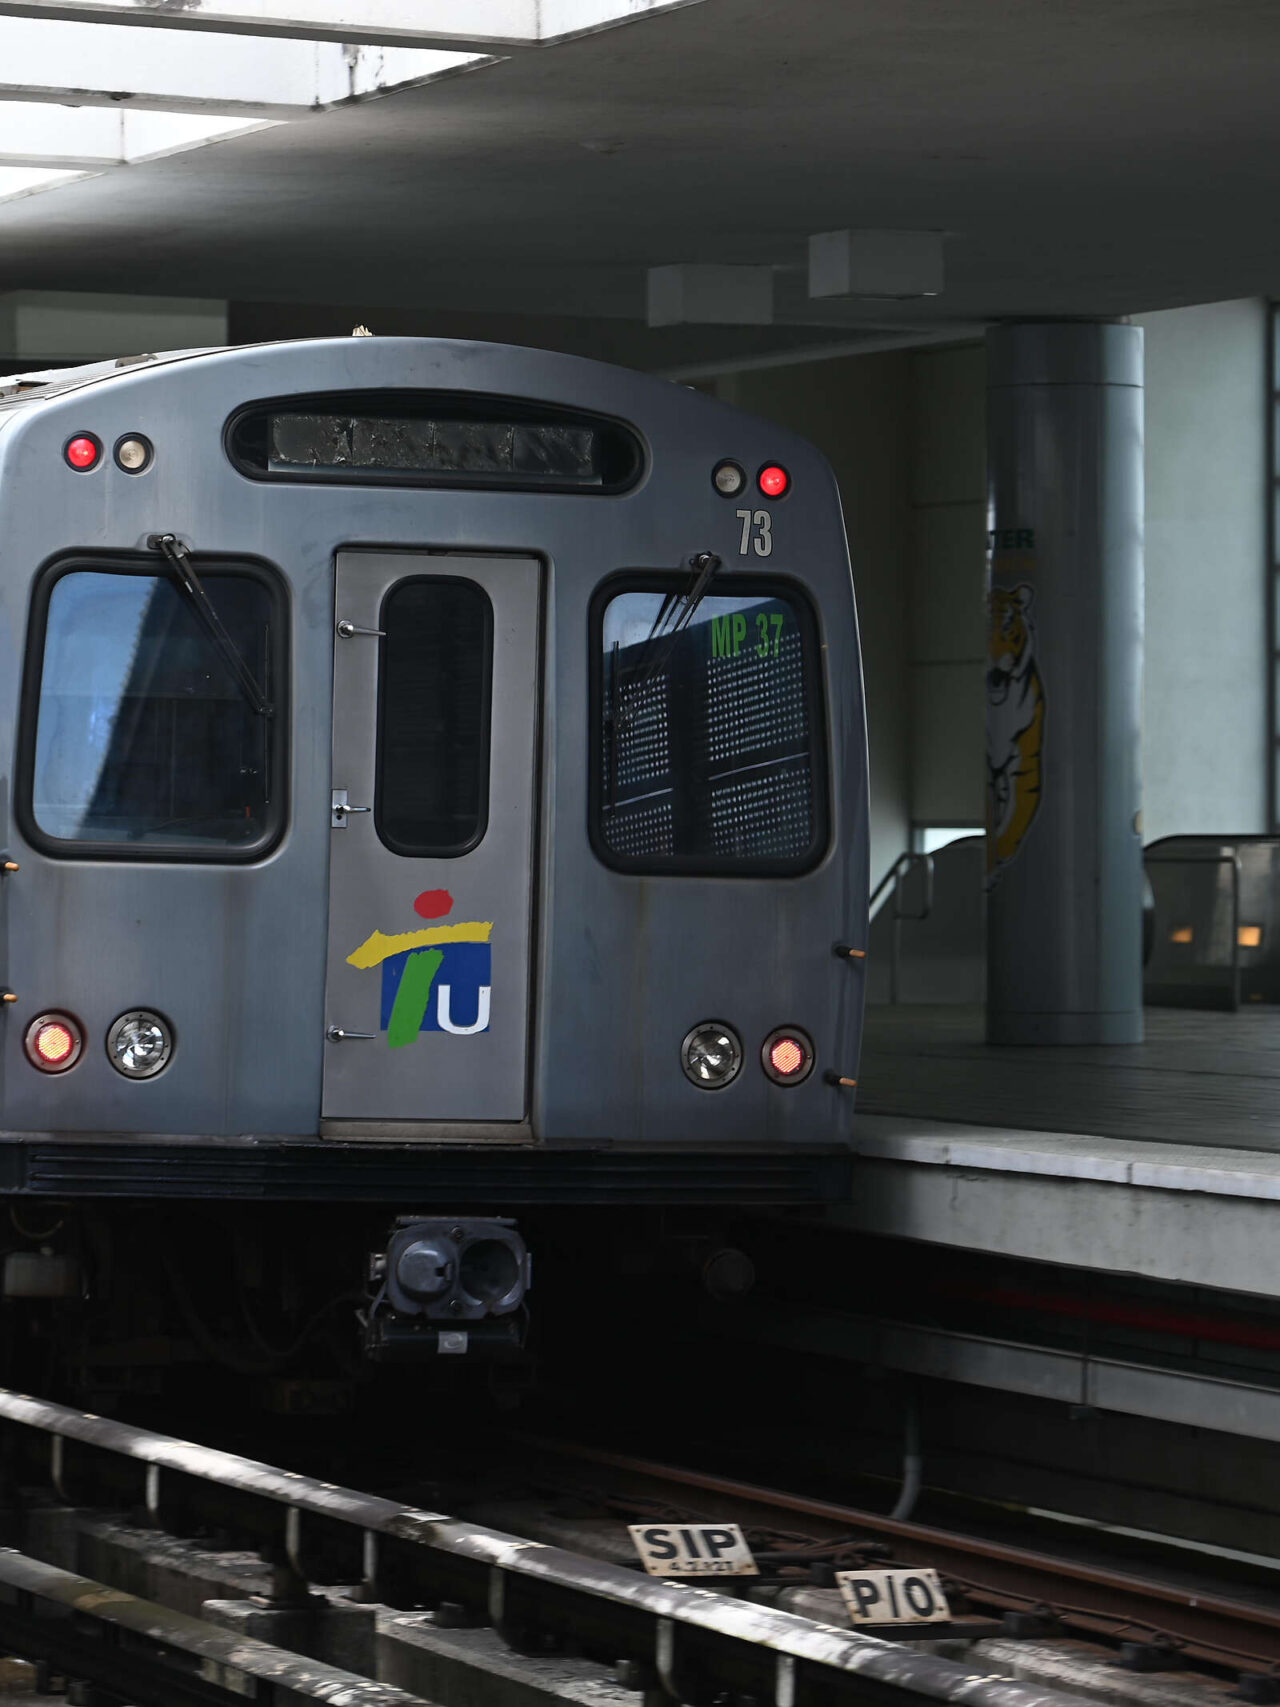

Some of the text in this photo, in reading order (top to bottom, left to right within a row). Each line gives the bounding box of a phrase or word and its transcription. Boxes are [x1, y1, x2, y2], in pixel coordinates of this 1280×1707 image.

[736, 509, 773, 557] 73
[711, 613, 784, 657] MP 37
[643, 1528, 737, 1560] SIP
